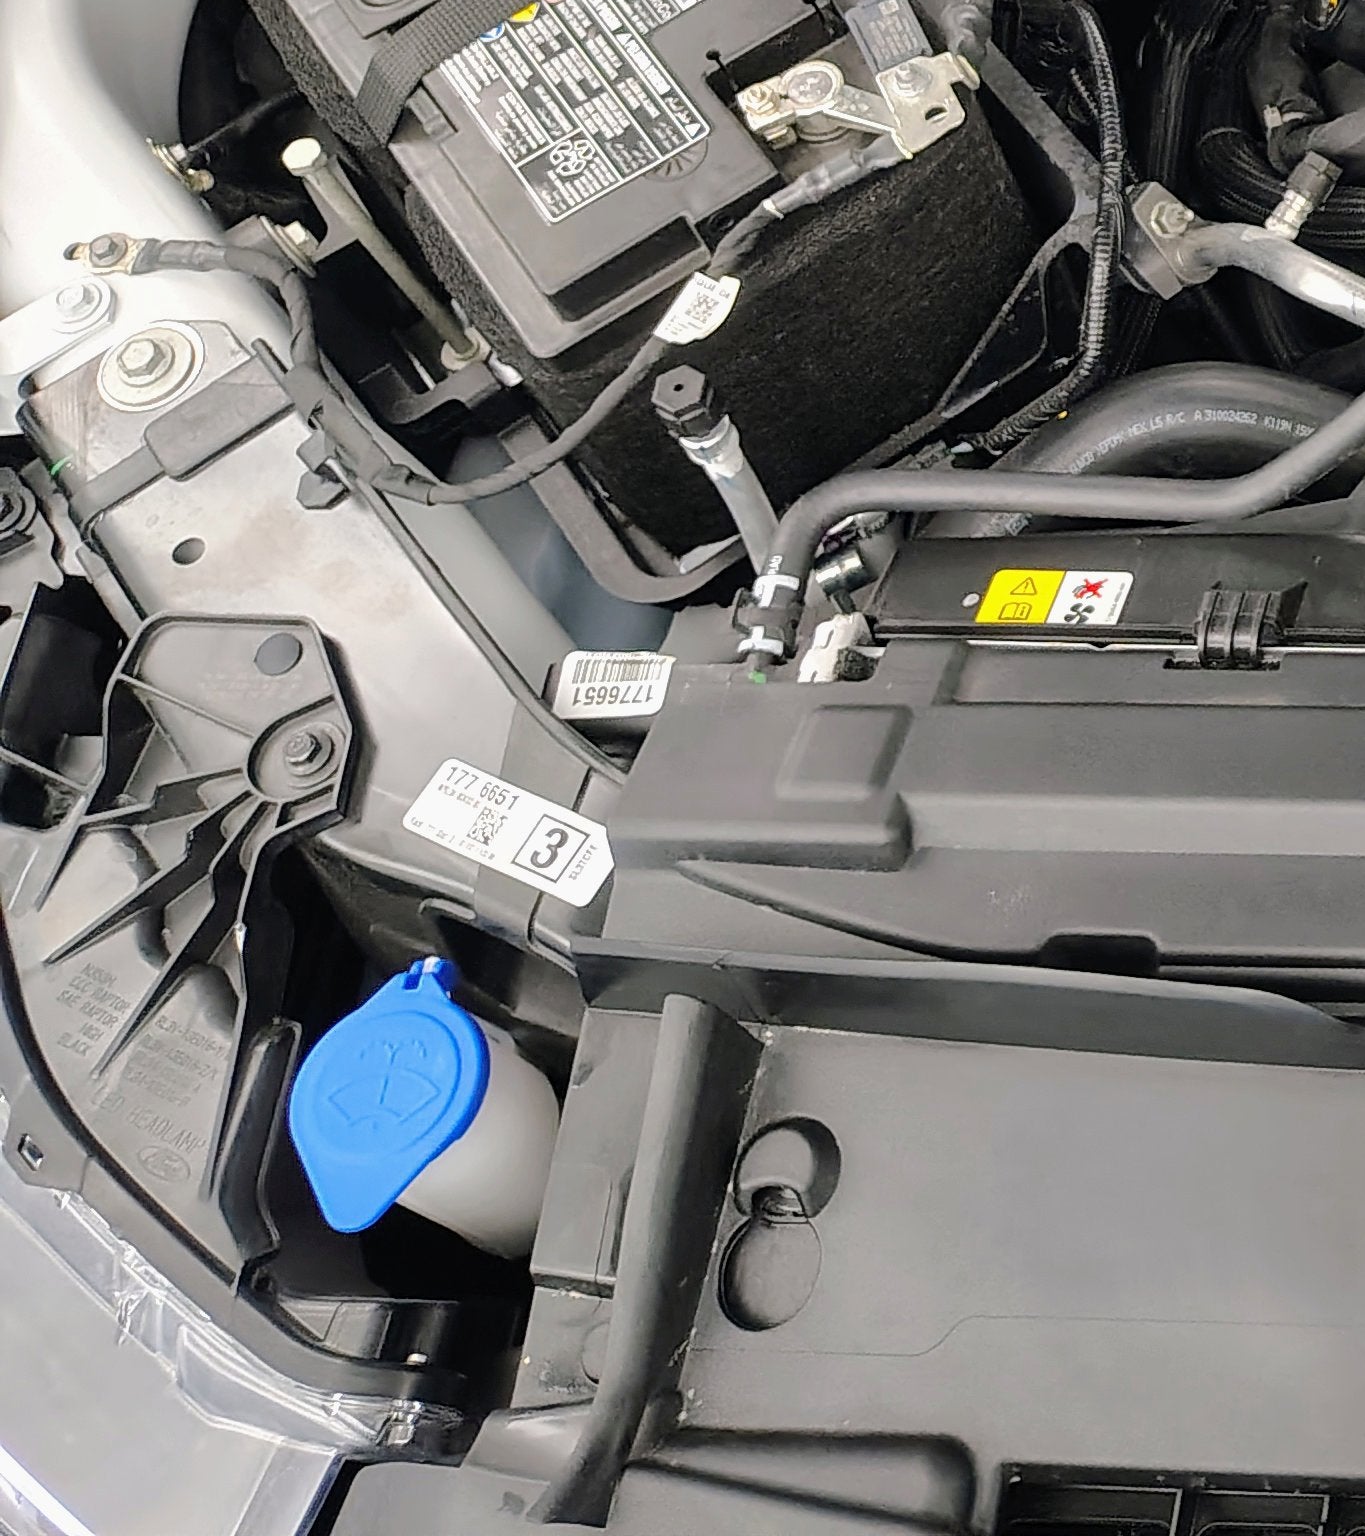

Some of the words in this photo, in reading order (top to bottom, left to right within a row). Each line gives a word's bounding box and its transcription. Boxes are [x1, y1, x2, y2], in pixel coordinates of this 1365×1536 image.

[1194, 410, 1202, 421] A
[572, 685, 653, 706] 1776651
[446, 766, 480, 789] 177
[479, 781, 520, 810] 6651
[530, 828, 569, 868] 3
[79, 1002, 118, 1028] RAPTOR
[127, 1106, 207, 1153] HEADLAMP
